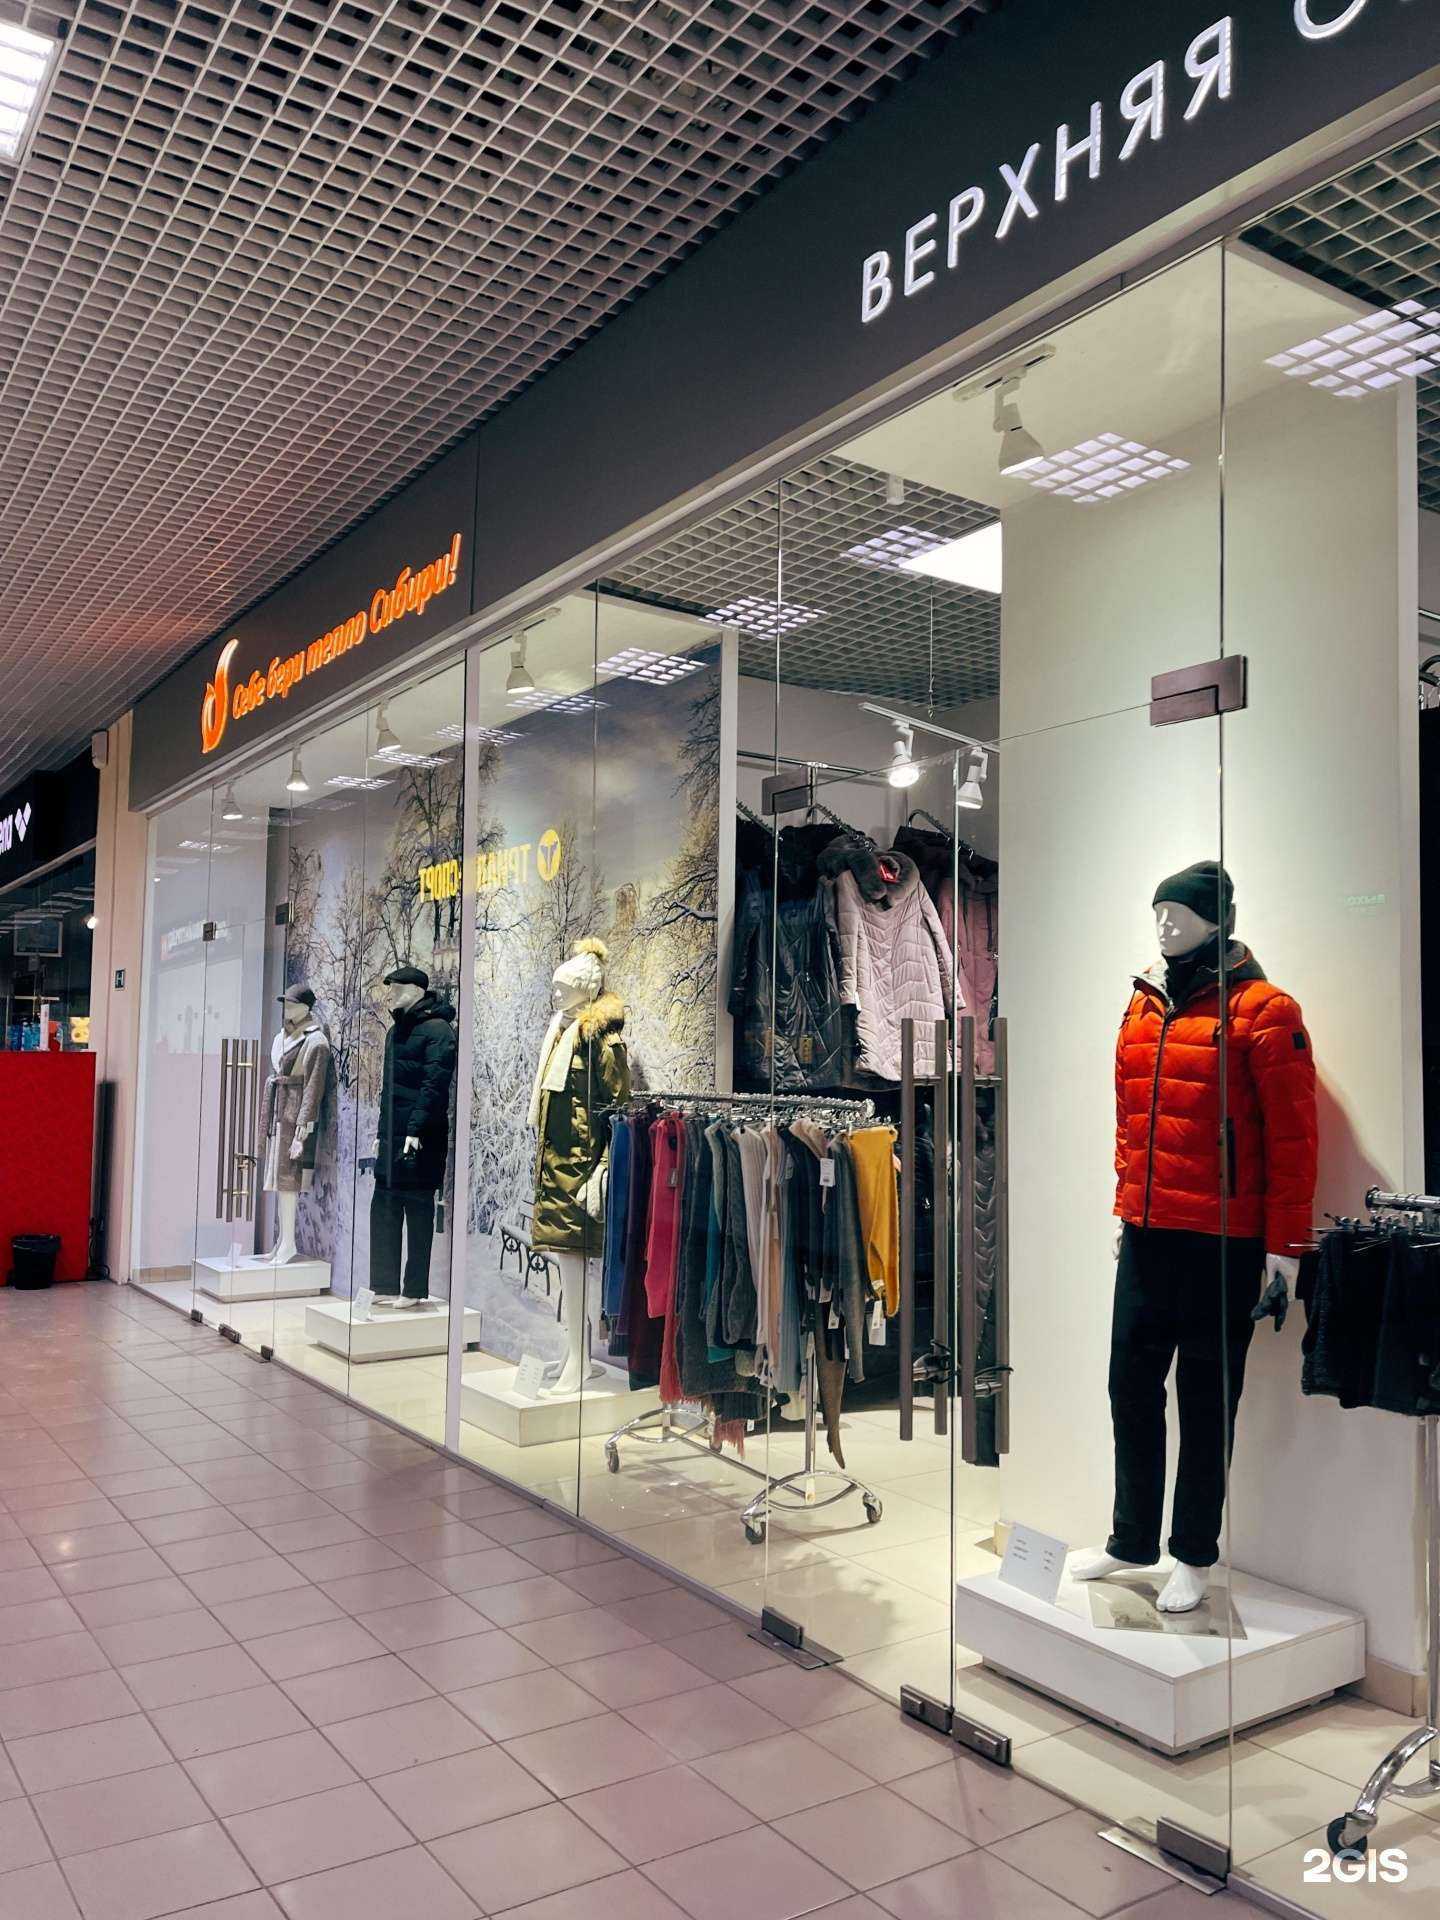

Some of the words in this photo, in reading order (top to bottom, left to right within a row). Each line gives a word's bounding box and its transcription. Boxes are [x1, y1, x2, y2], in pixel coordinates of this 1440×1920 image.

[861, 15, 1233, 324] ВЕРХНЯЯ
[232, 670, 265, 720] Себе
[266, 656, 305, 698] бери
[306, 610, 367, 675] тепло
[369, 532, 462, 635] Сибири!
